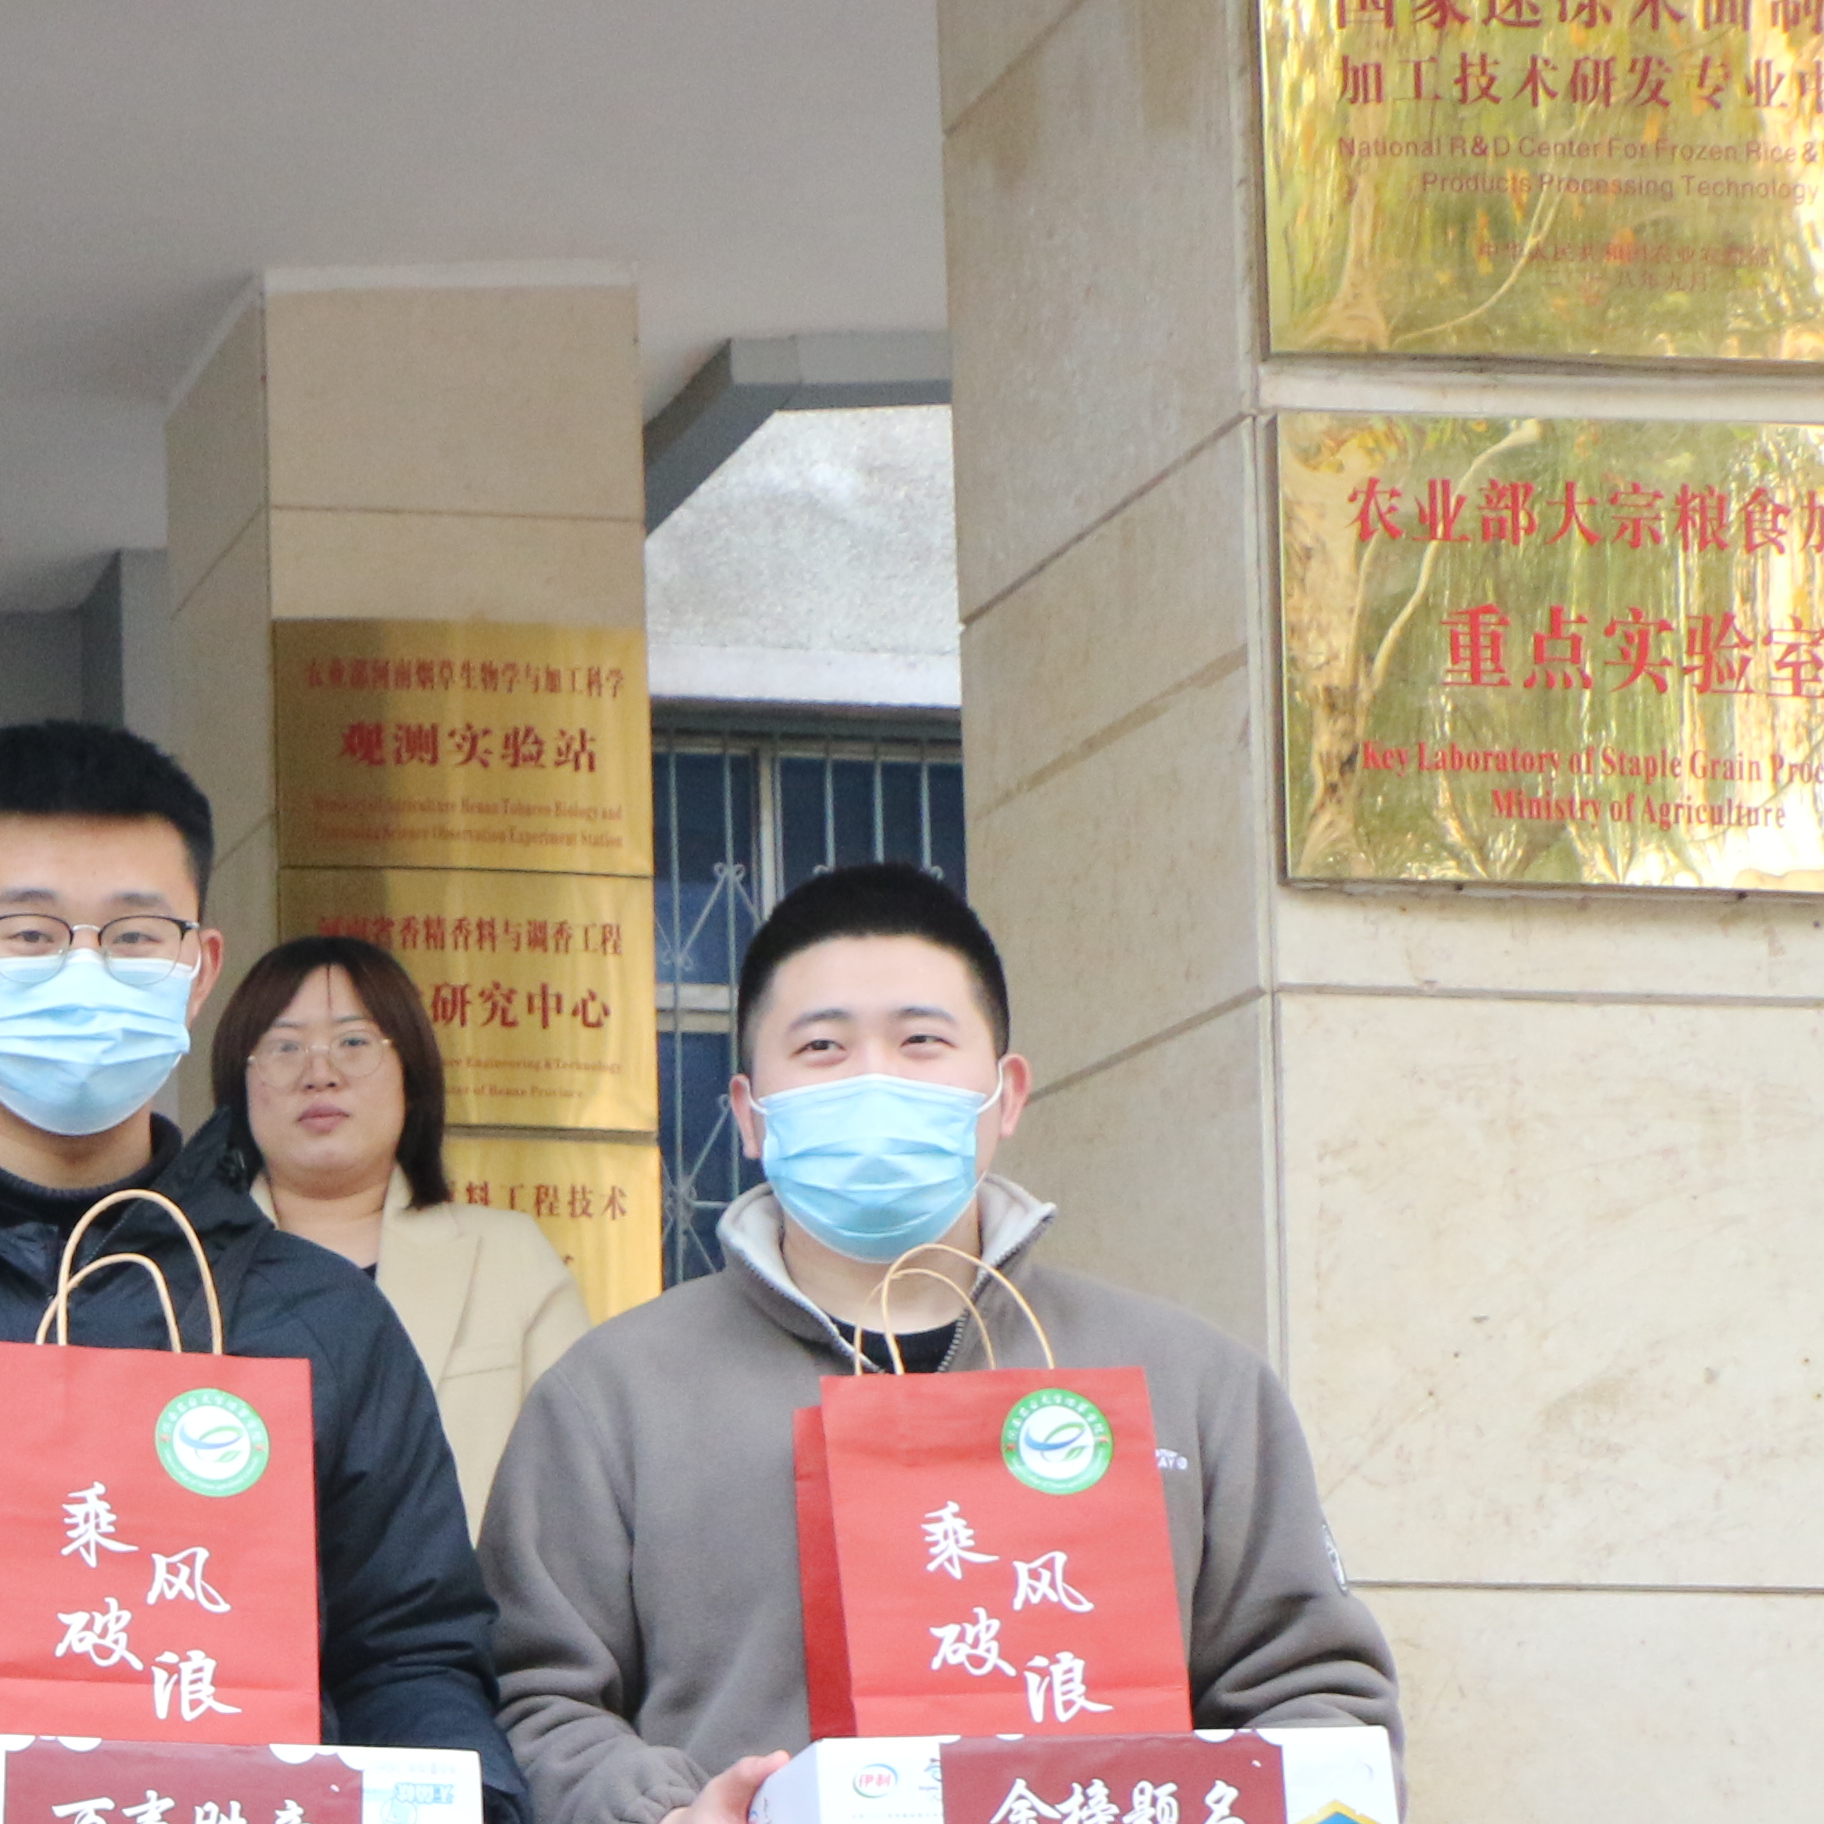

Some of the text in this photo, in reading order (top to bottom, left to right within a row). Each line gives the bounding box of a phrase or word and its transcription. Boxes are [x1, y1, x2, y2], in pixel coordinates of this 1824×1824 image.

[1338, 136, 1818, 164] National R&D Center For Frozen Rice &
[1422, 172, 1820, 205] Products Processing Technology
[1440, 603, 1824, 700] 重点实验室
[339, 721, 597, 772] 观测实验站
[1362, 740, 1407, 777] Key
[1417, 742, 1560, 776] Laboratory
[1569, 746, 1595, 776] of
[1601, 748, 1683, 785] Staple
[1689, 750, 1762, 783] Grain
[1490, 789, 1787, 832] Ministry of Agriculture
[430, 980, 611, 1030] 研究中心
[60, 1481, 231, 1613] 乘风
[920, 1500, 1094, 1613] 乘风
[54, 1597, 242, 1722] 破浪
[929, 1607, 1113, 1723] 破浪
